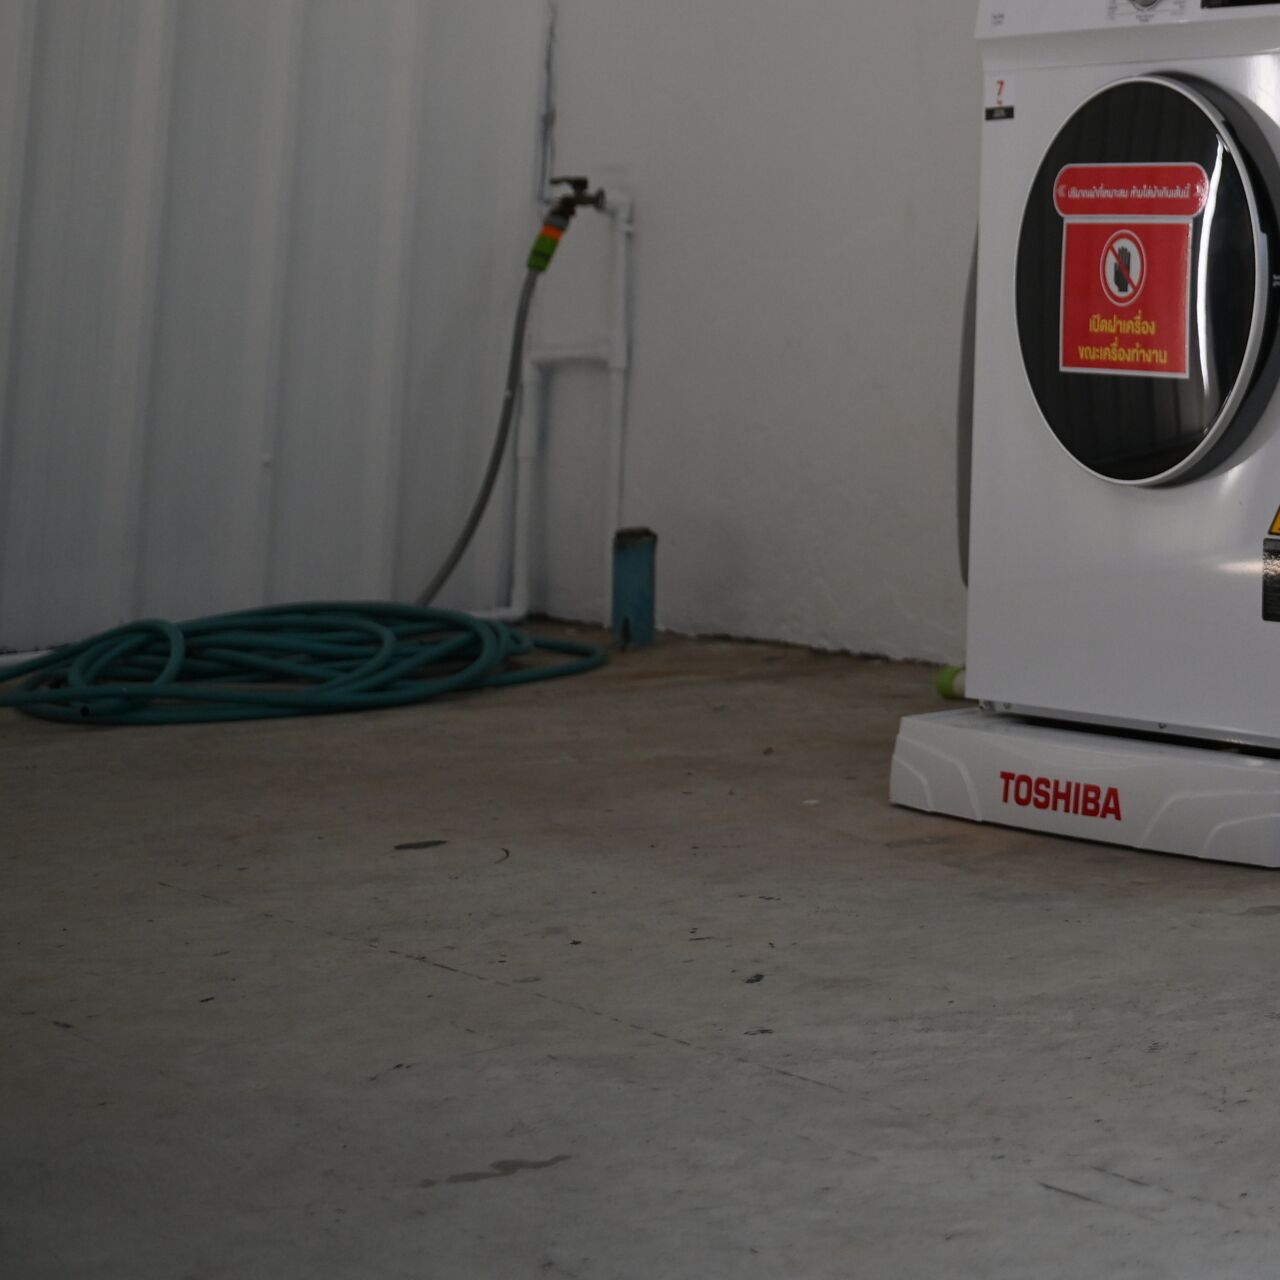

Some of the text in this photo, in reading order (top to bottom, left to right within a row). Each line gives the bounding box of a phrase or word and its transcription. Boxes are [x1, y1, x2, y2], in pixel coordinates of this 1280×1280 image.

[1089, 308, 1157, 336] เปิดฝาเครื่อง
[1077, 335, 1168, 365] ขณะเครื่องทำงาน
[1000, 771, 1122, 821] TOSHIBA
